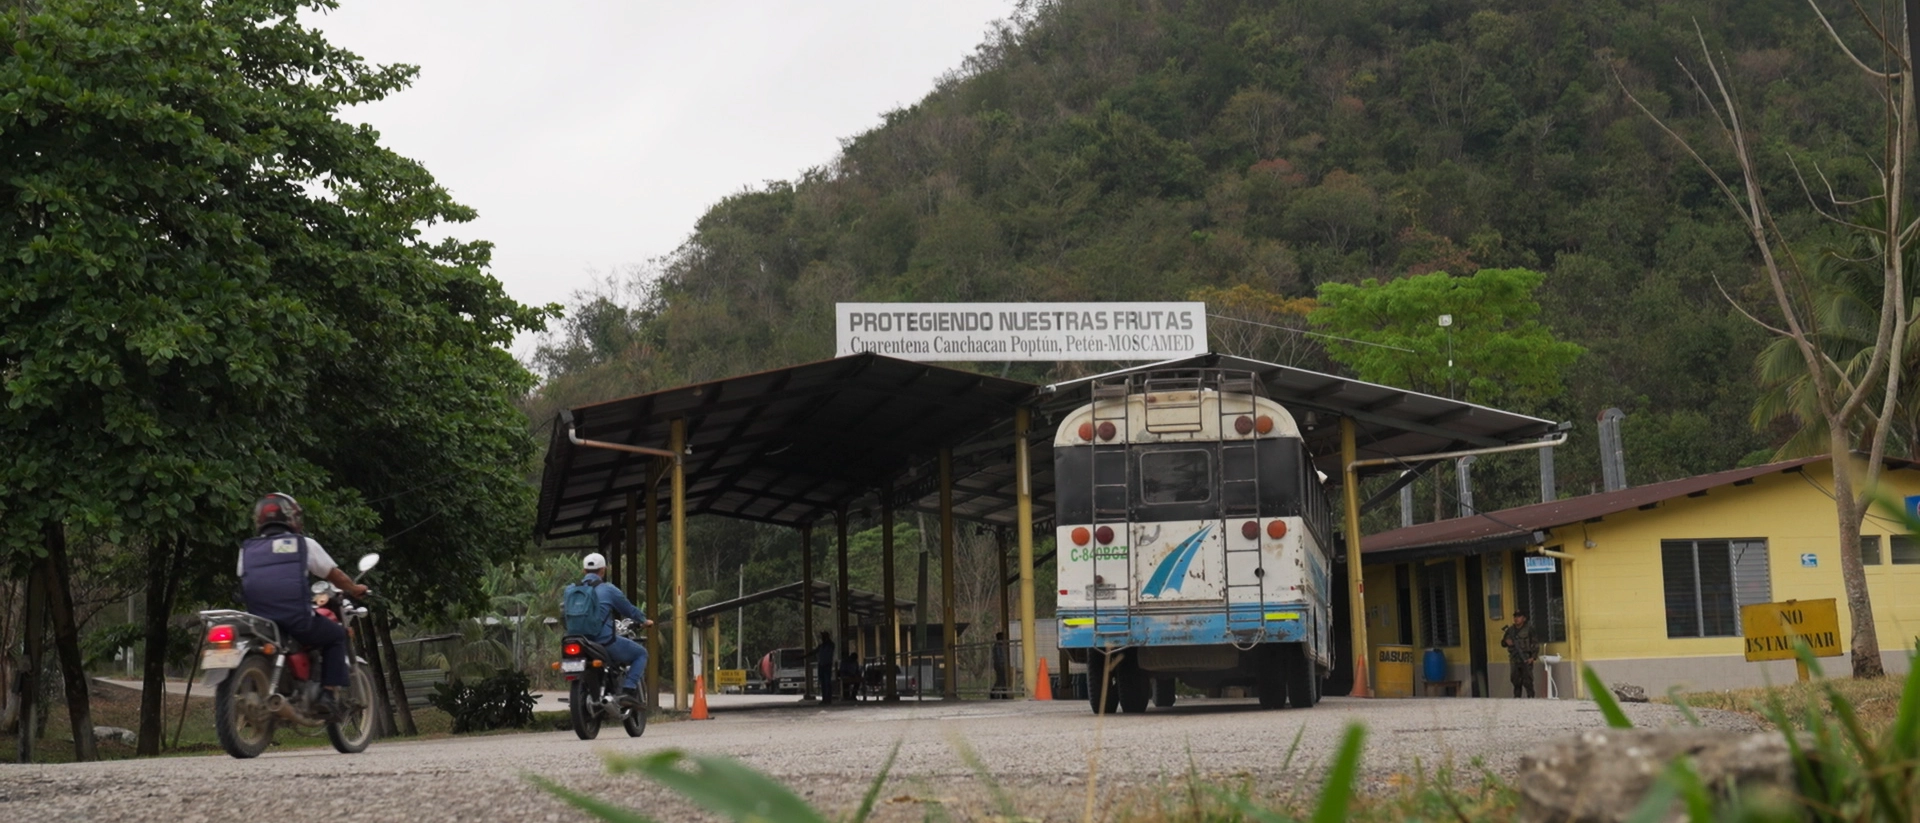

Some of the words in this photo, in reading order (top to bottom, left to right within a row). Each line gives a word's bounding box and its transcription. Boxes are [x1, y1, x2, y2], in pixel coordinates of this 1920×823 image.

[850, 312, 993, 332] PROTEGIENDO
[1000, 311, 1108, 331] NUESTRAS
[1113, 311, 1193, 330] FRUTAS
[850, 336, 930, 354] Cuarentena
[933, 335, 1007, 353] Canchacan
[1010, 335, 1062, 357] Poptún,
[1065, 334, 1194, 352] Petén-MOSCAMED
[1780, 609, 1803, 627] NO
[1746, 632, 1835, 653] ESTACNAR
